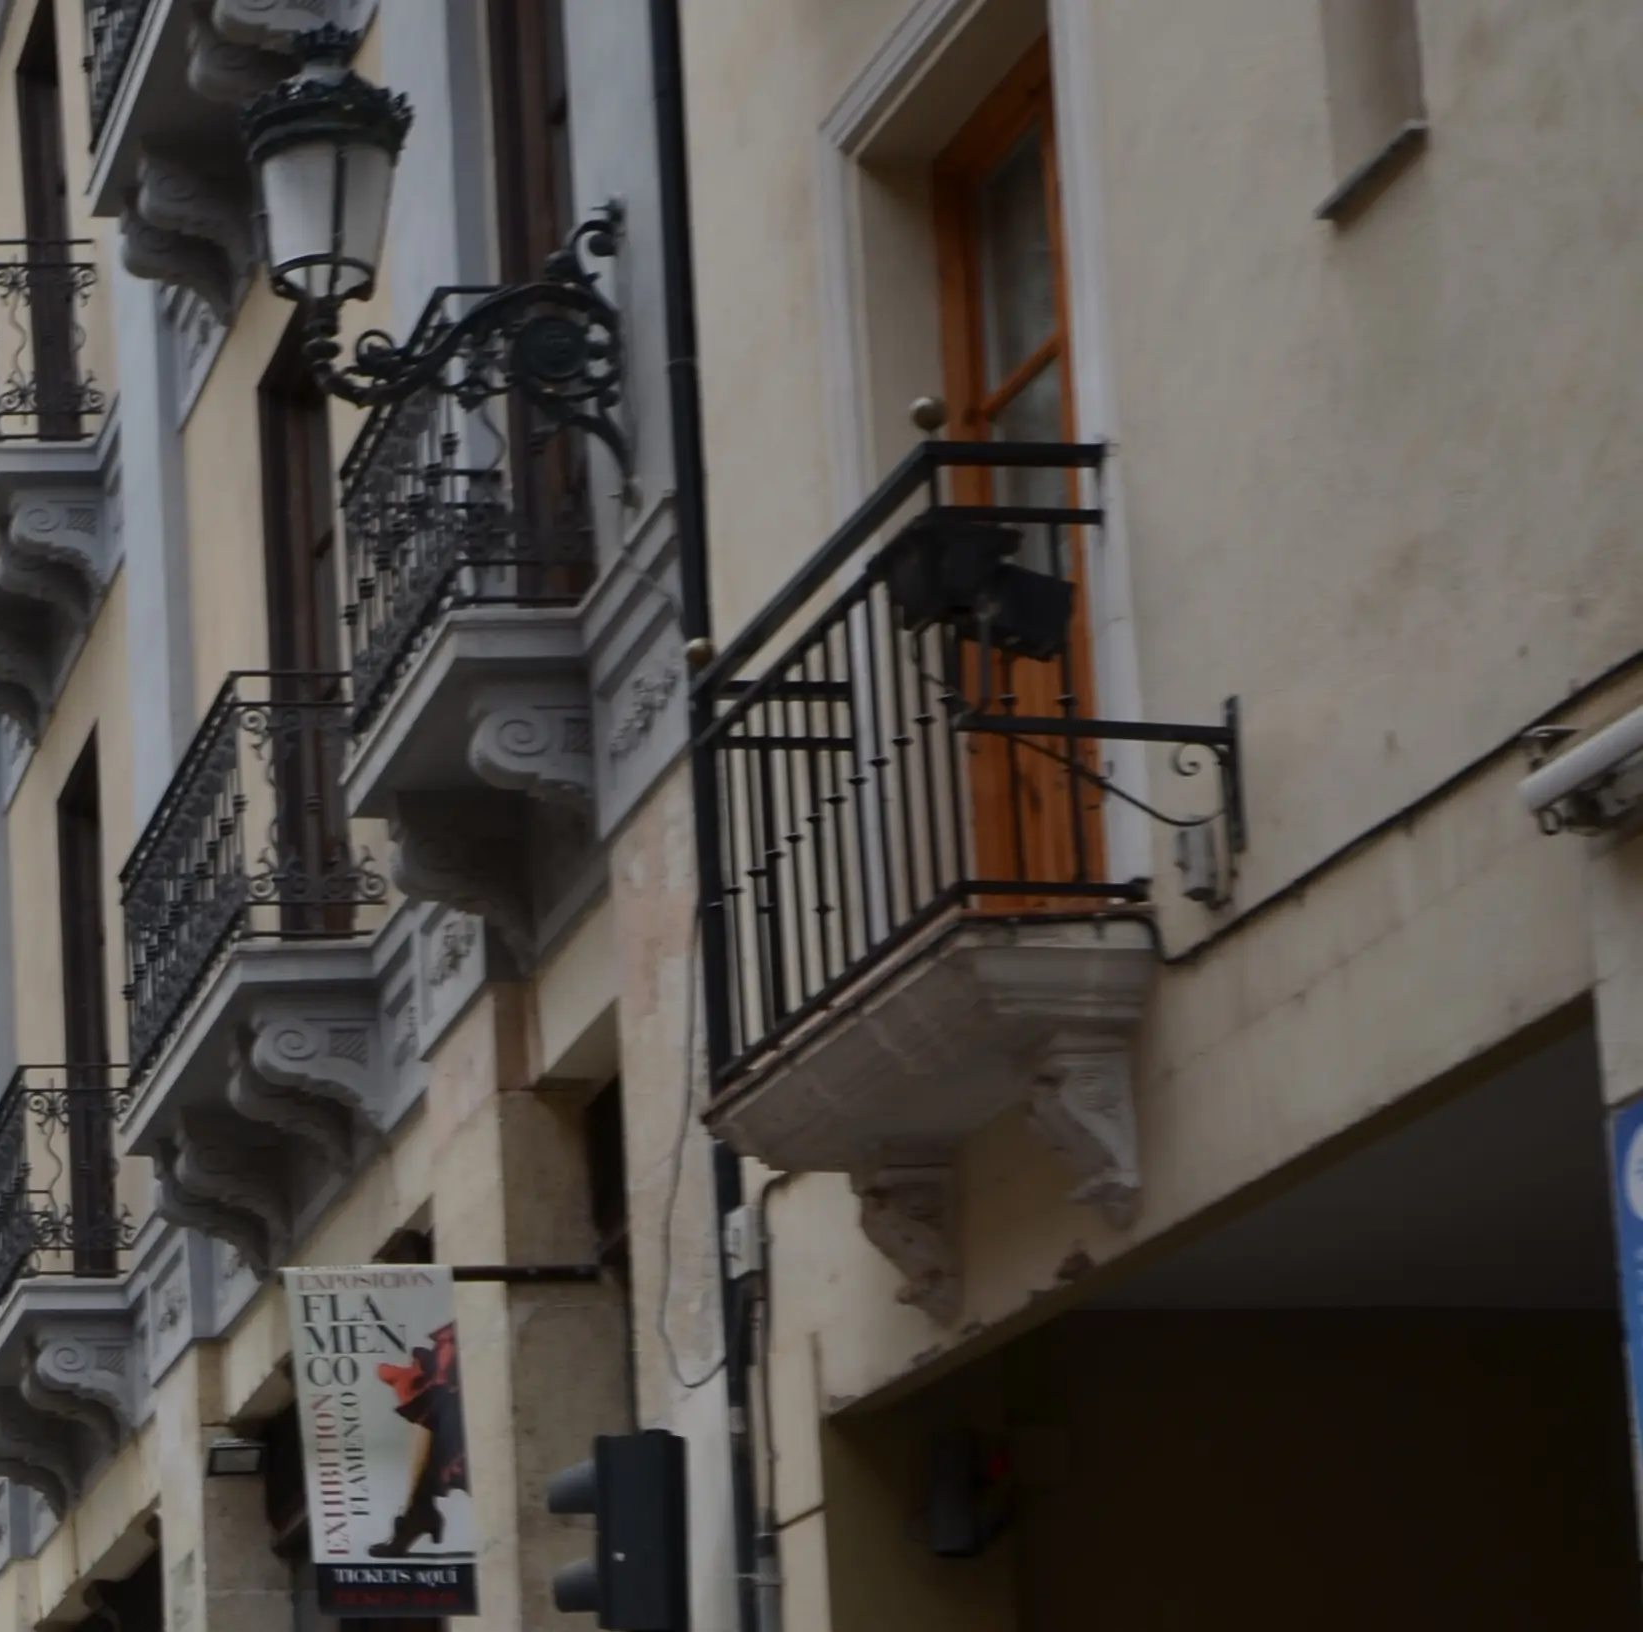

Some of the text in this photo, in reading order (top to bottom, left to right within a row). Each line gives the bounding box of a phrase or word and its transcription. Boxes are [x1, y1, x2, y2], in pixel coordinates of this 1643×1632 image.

[298, 1270, 434, 1290] EXPOSICIÓN
[299, 1294, 387, 1323] FLA
[305, 1325, 409, 1355] MEN
[307, 1356, 360, 1387] CO
[341, 1392, 371, 1517] FLAMENCO
[311, 1394, 351, 1556] EXHIBITION
[333, 1566, 459, 1588] TICKETS AQUÍ
